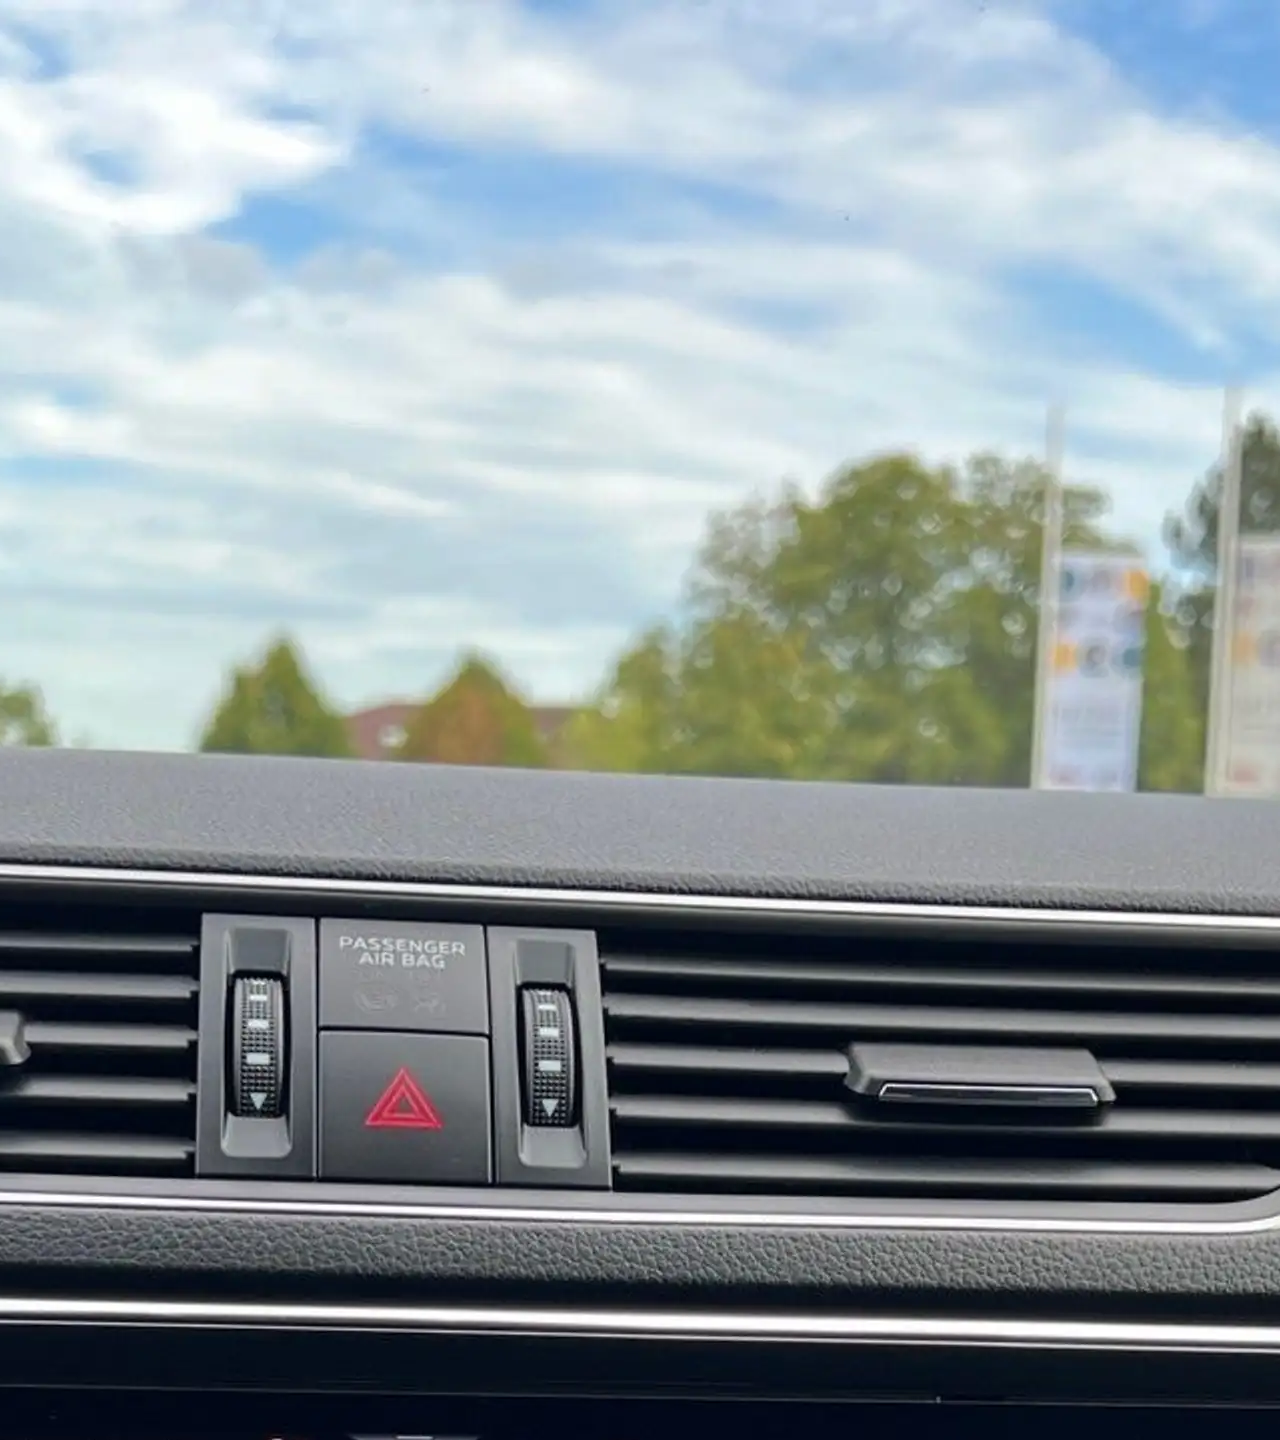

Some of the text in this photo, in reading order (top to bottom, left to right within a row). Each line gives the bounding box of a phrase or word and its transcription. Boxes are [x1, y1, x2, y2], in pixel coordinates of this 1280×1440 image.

[339, 936, 466, 956] PASSENGER
[359, 951, 447, 970] AIR BAG
